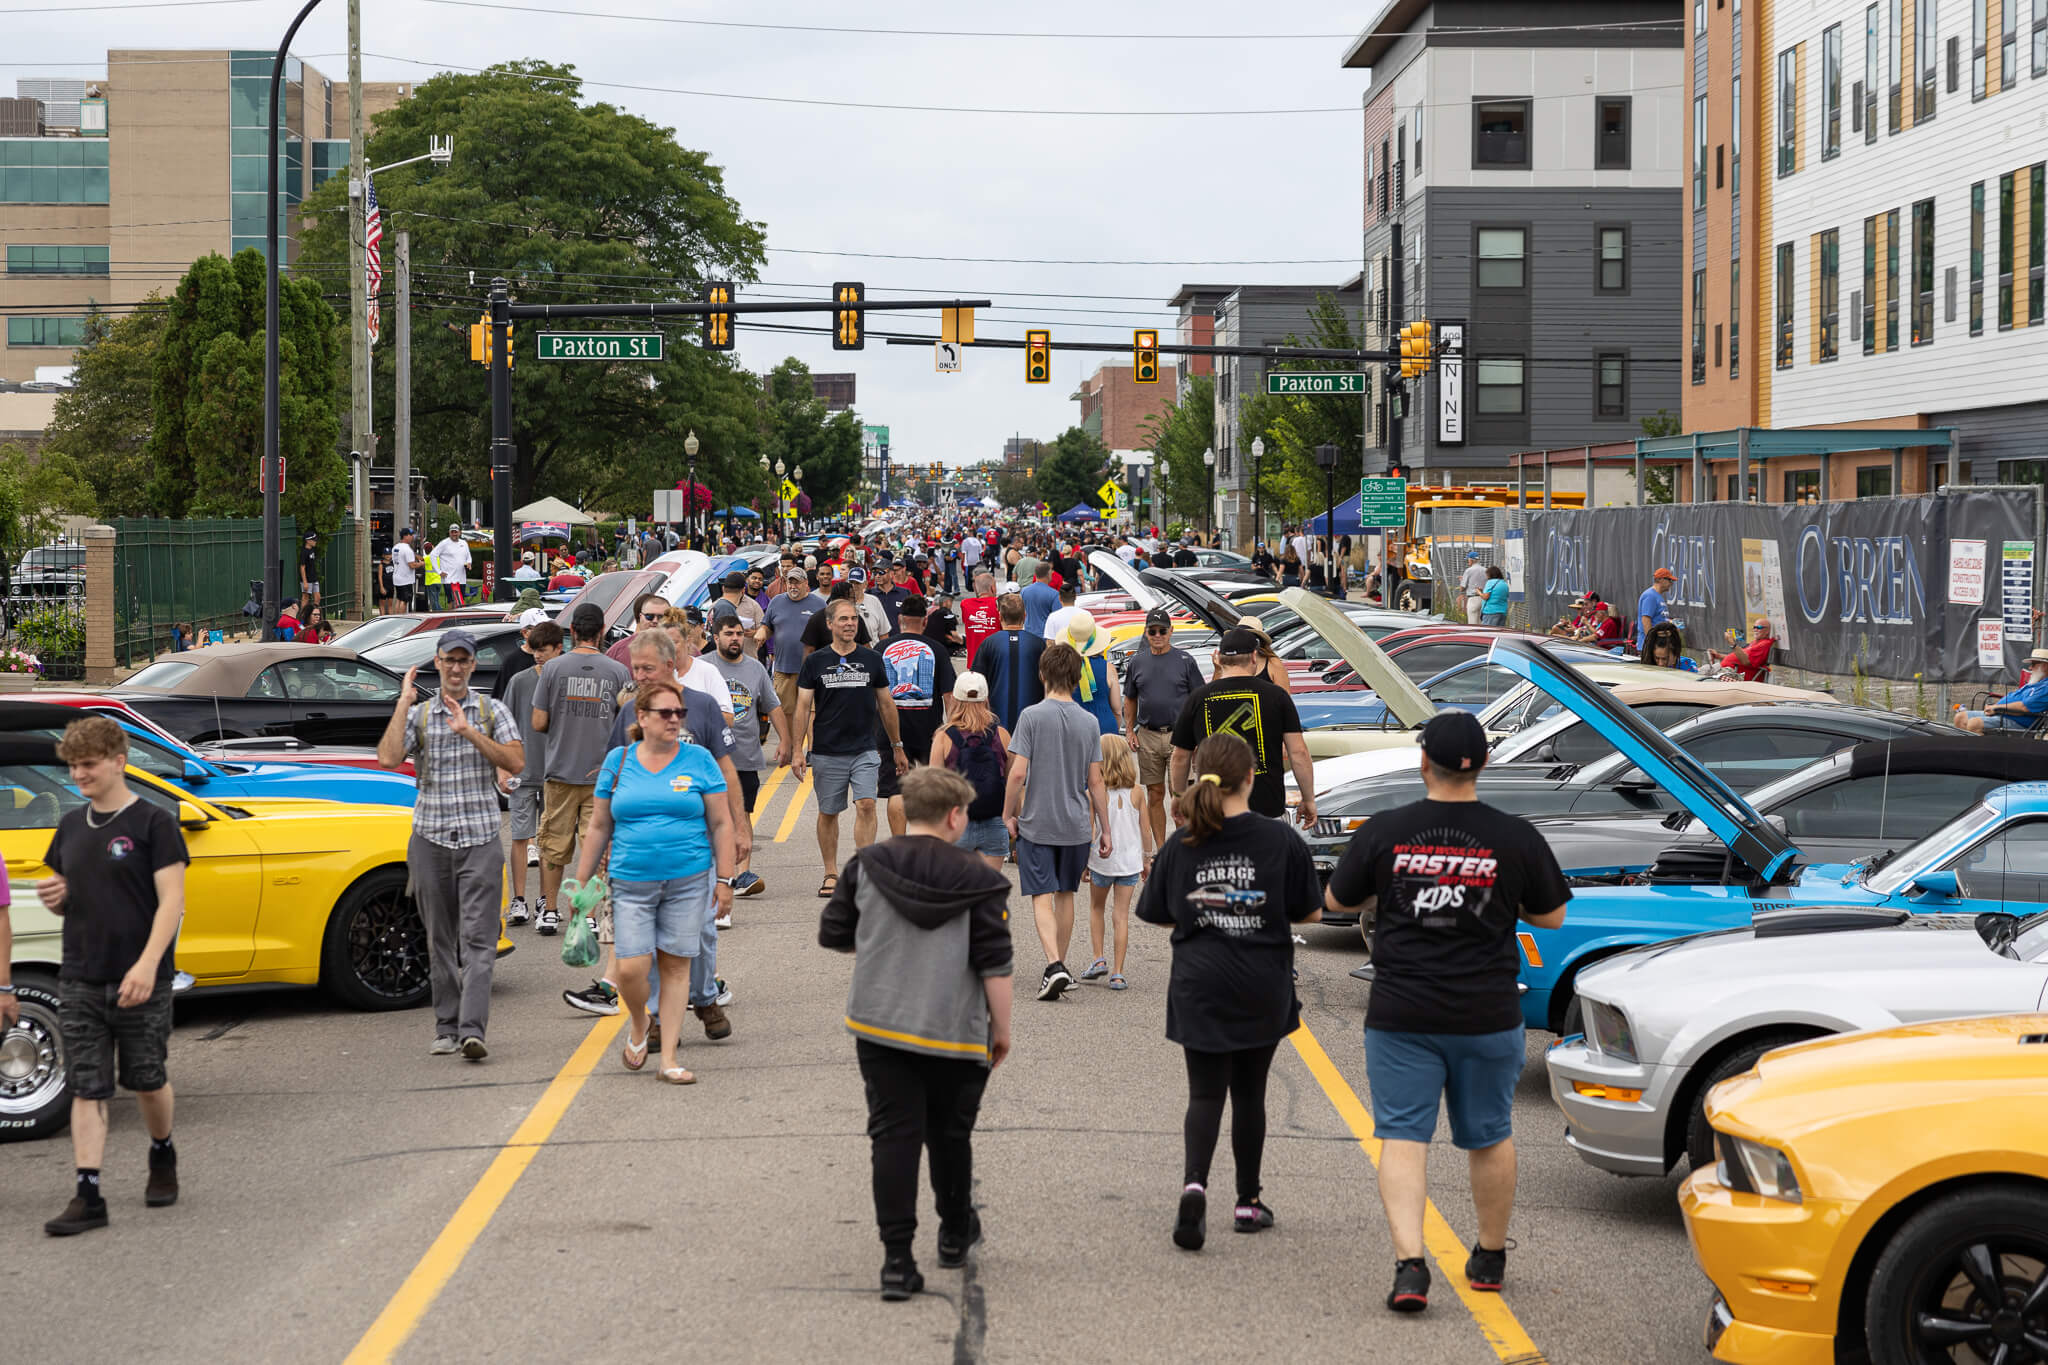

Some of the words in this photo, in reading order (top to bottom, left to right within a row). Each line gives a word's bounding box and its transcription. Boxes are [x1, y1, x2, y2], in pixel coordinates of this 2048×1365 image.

[552, 338, 620, 356] Paxton
[629, 338, 648, 356] St
[1279, 376, 1333, 391] Paxton
[1339, 376, 1355, 391] St
[1445, 364, 1457, 433] NINE
[1796, 512, 1926, 624] O'BRIEN
[567, 677, 598, 697] mach
[1392, 844, 1410, 854] MY
[1410, 845, 1434, 855] CAR
[1435, 846, 1477, 856] WOULD
[1477, 848, 1494, 858] BE
[1392, 853, 1498, 878] FASTER.
[1195, 867, 1256, 884] GARAGE
[1437, 876, 1460, 885] BUT
[1465, 877, 1496, 887] HAVE
[1412, 884, 1467, 919] KIDS
